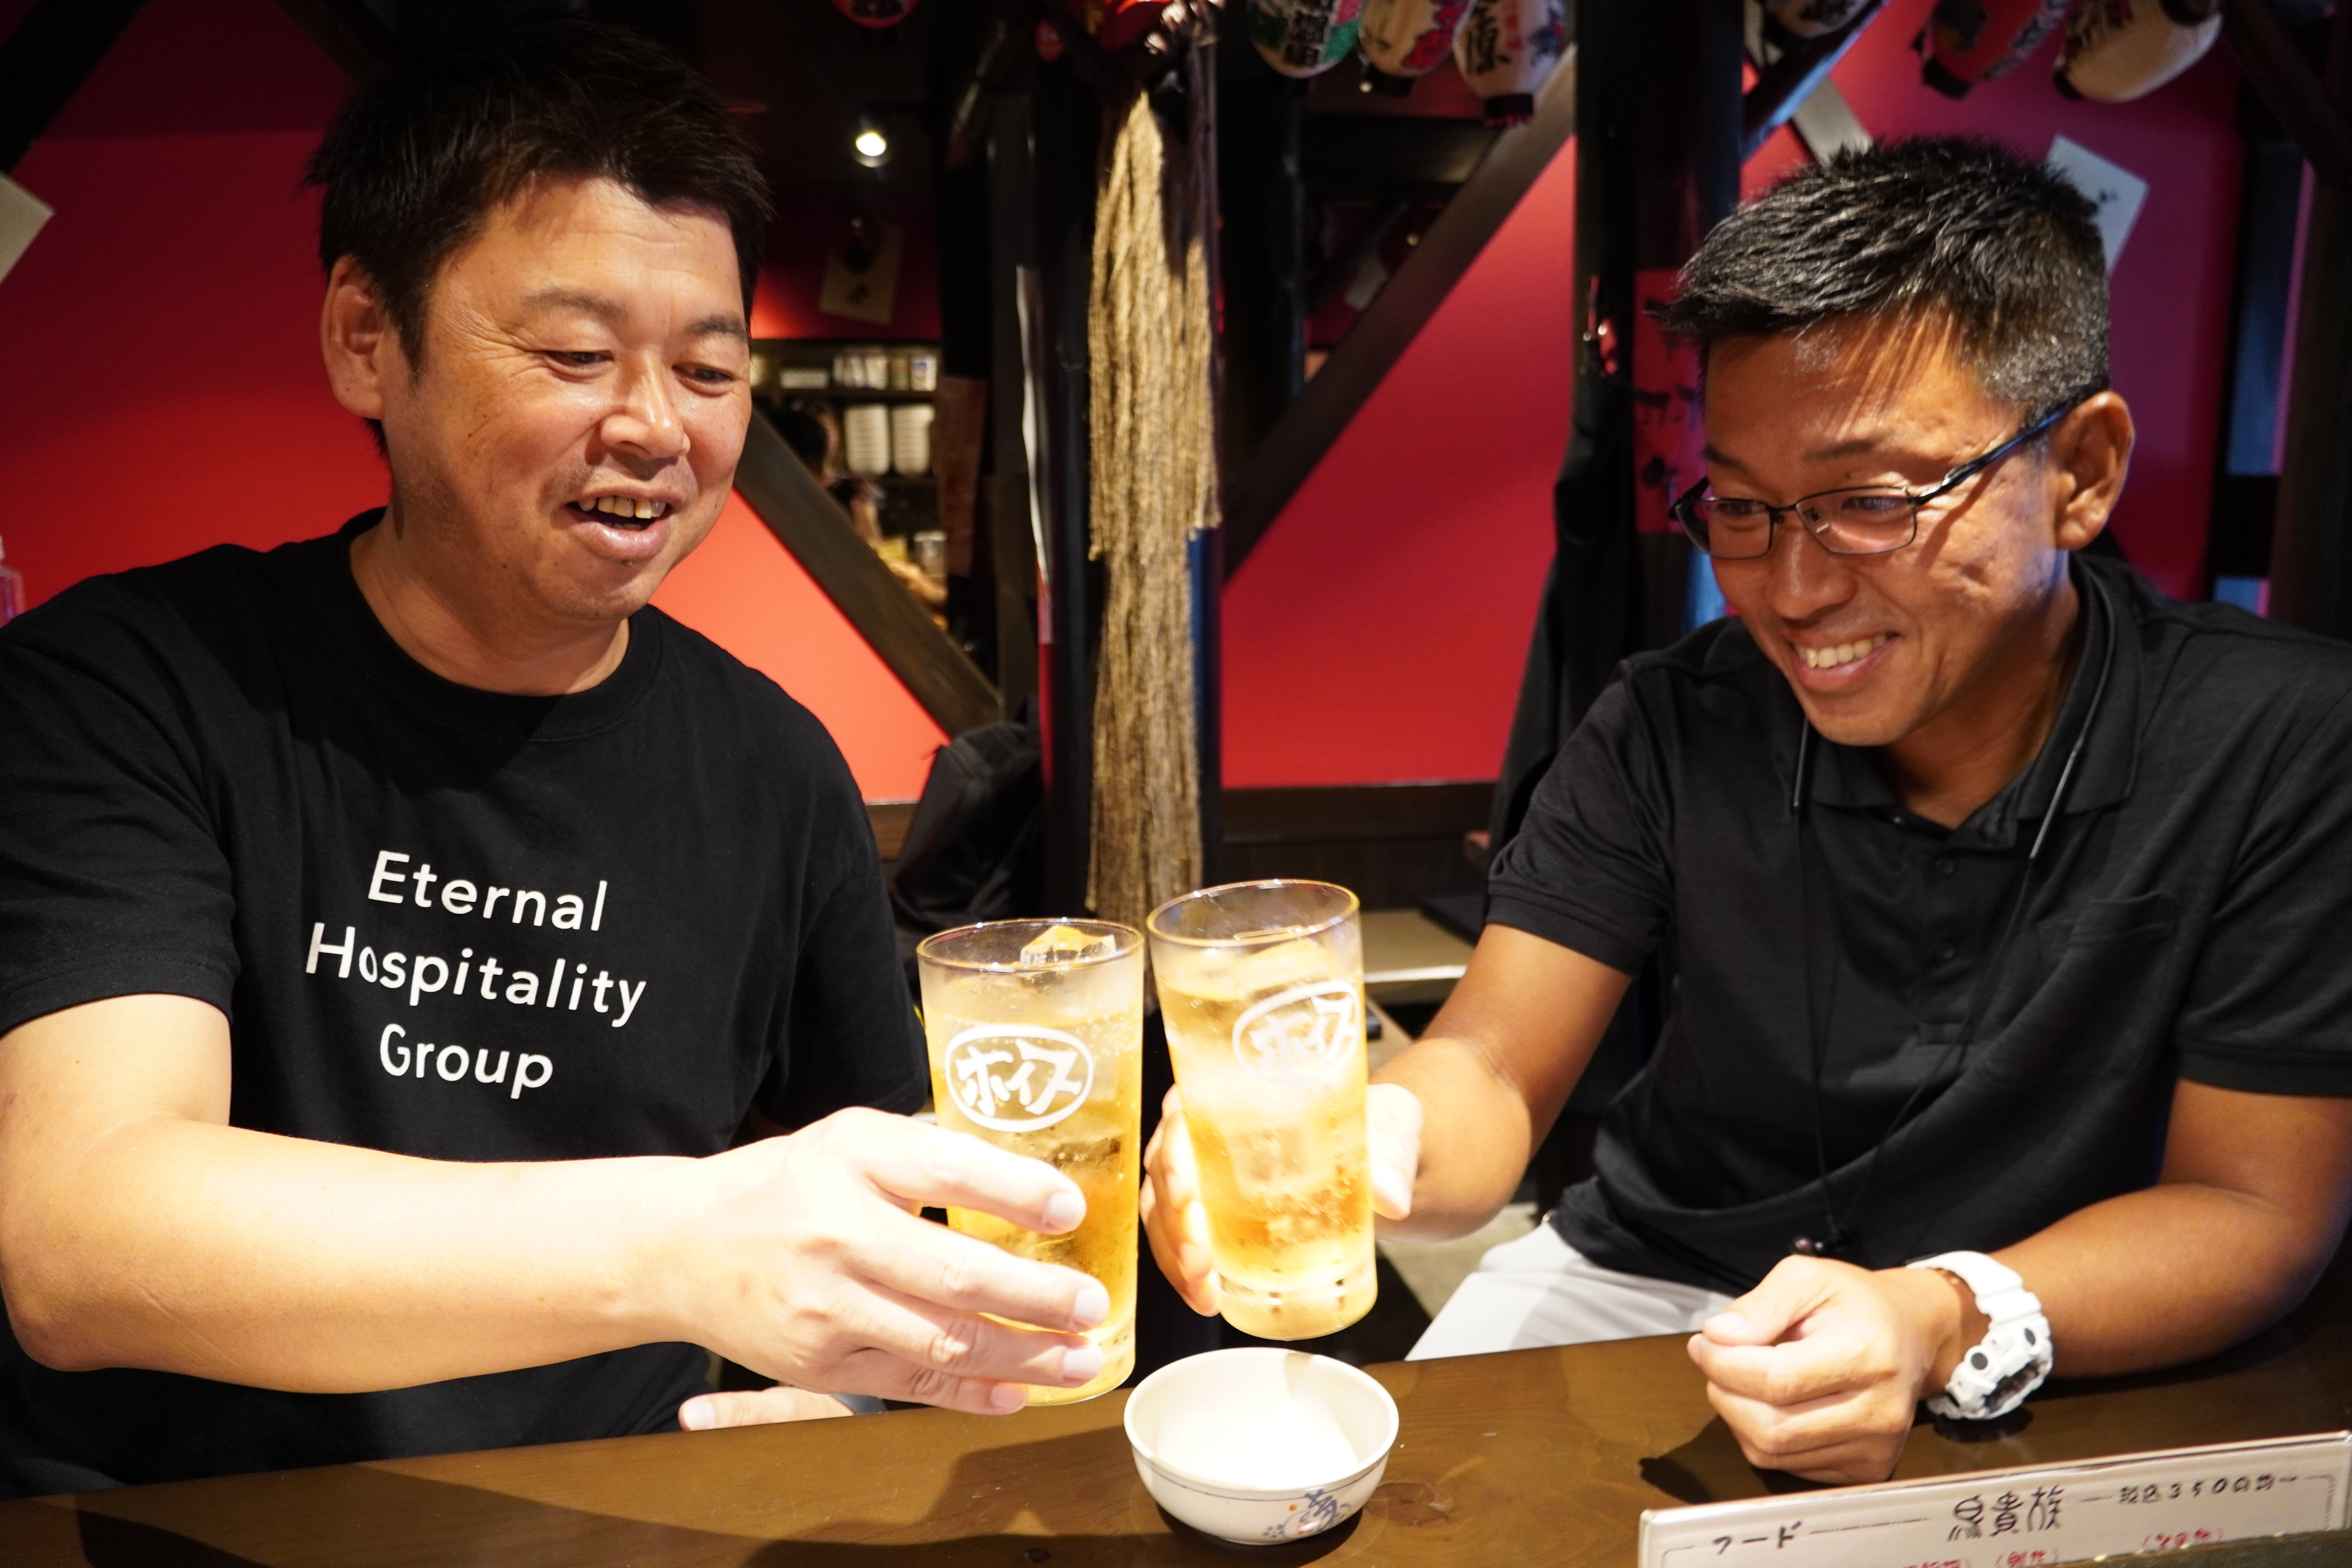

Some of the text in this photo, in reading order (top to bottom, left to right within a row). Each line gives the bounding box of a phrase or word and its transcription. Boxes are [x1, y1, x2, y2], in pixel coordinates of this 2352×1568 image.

[368, 850, 608, 931] Eternal
[306, 922, 647, 1028] Hospitality
[380, 1023, 553, 1100] Group
[955, 1038, 1082, 1117] ホイス
[1712, 1520, 1803, 1555] フード
